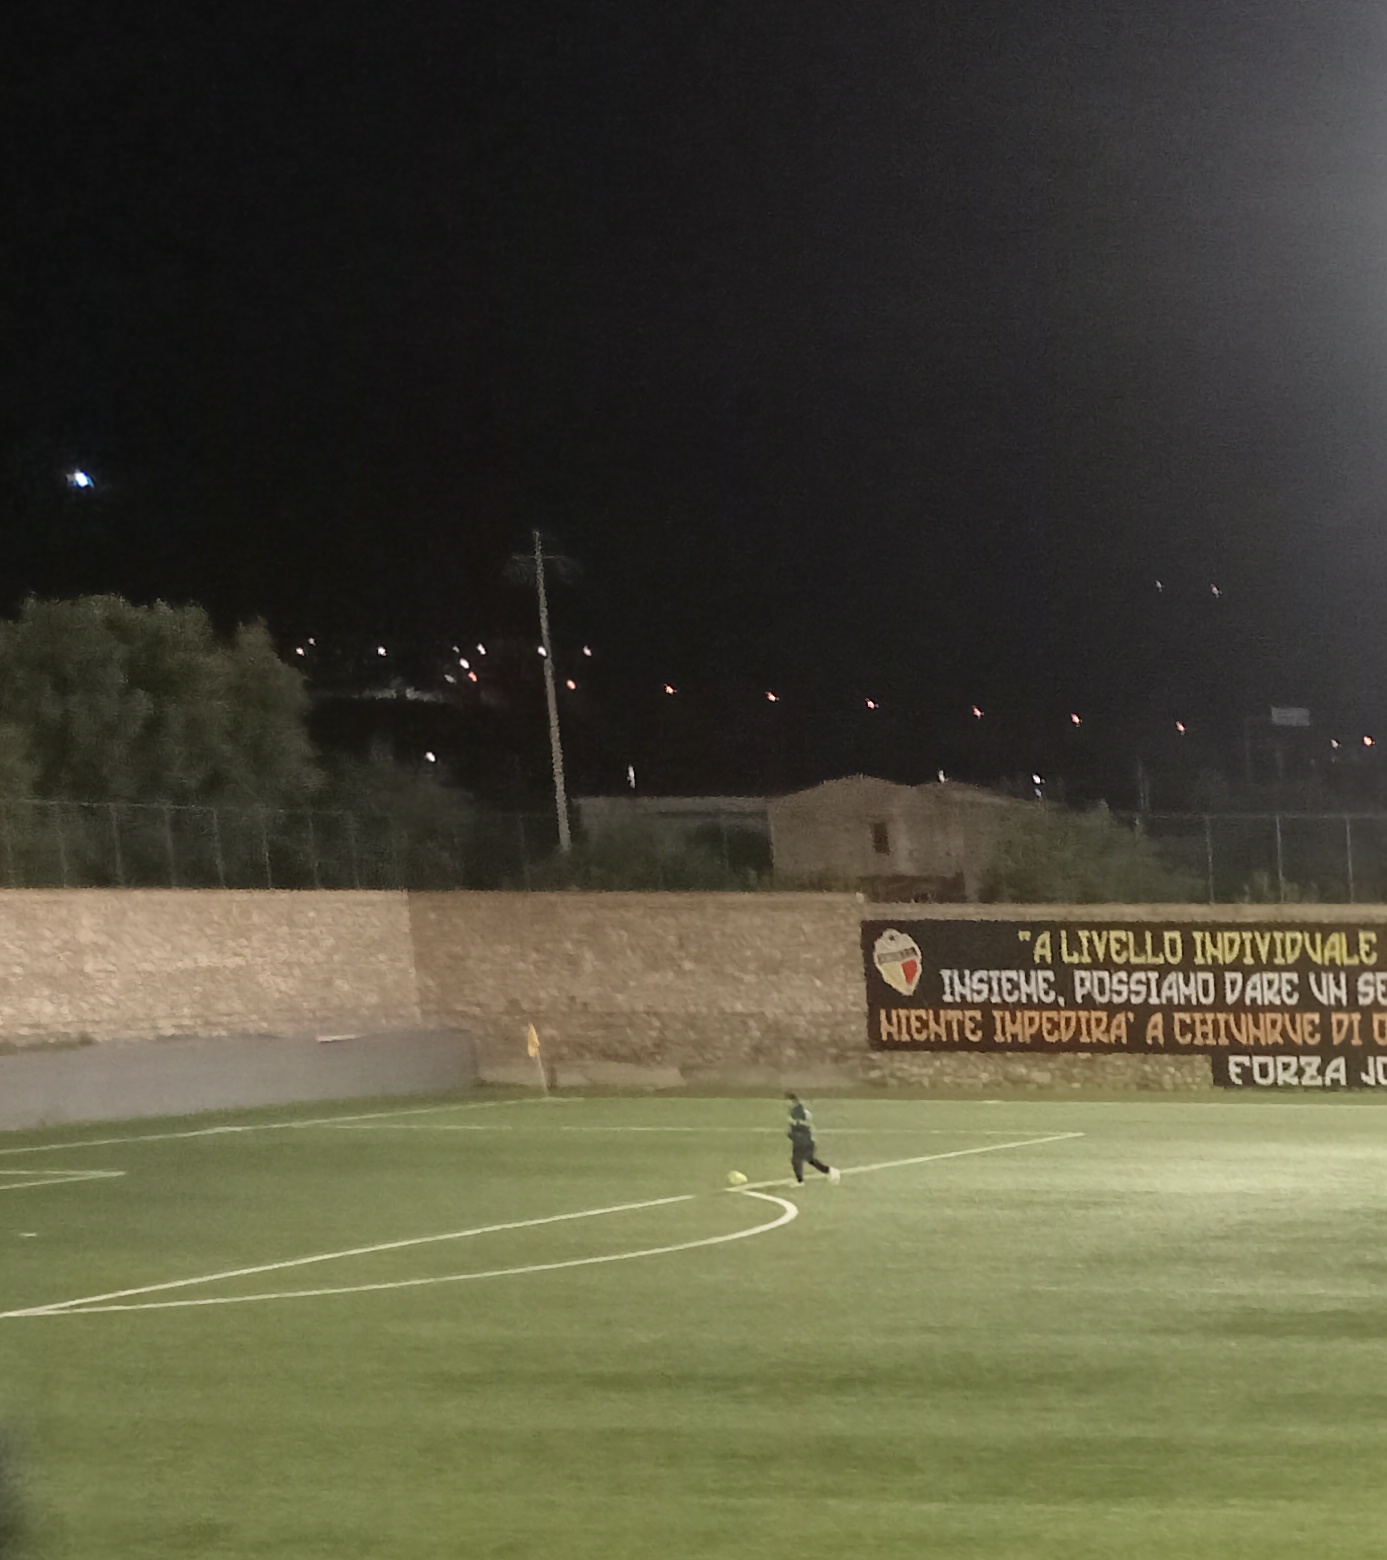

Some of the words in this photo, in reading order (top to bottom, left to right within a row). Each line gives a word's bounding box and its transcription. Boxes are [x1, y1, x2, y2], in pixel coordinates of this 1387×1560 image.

[1060, 930, 1183, 965] LIVELLO
[1192, 930, 1378, 966] INDIVIDUALE
[939, 969, 1065, 1008] INSIEME,
[1074, 969, 1215, 1006] POSSIAMO
[1224, 971, 1300, 1006] DARE
[1309, 971, 1347, 1007] UN
[879, 1008, 983, 1043] NIENTE
[1145, 1011, 1165, 1046] A
[1172, 1012, 1321, 1047] CHIUNQUE
[1331, 1012, 1363, 1046] DI
[1228, 1055, 1347, 1087] FORZA
